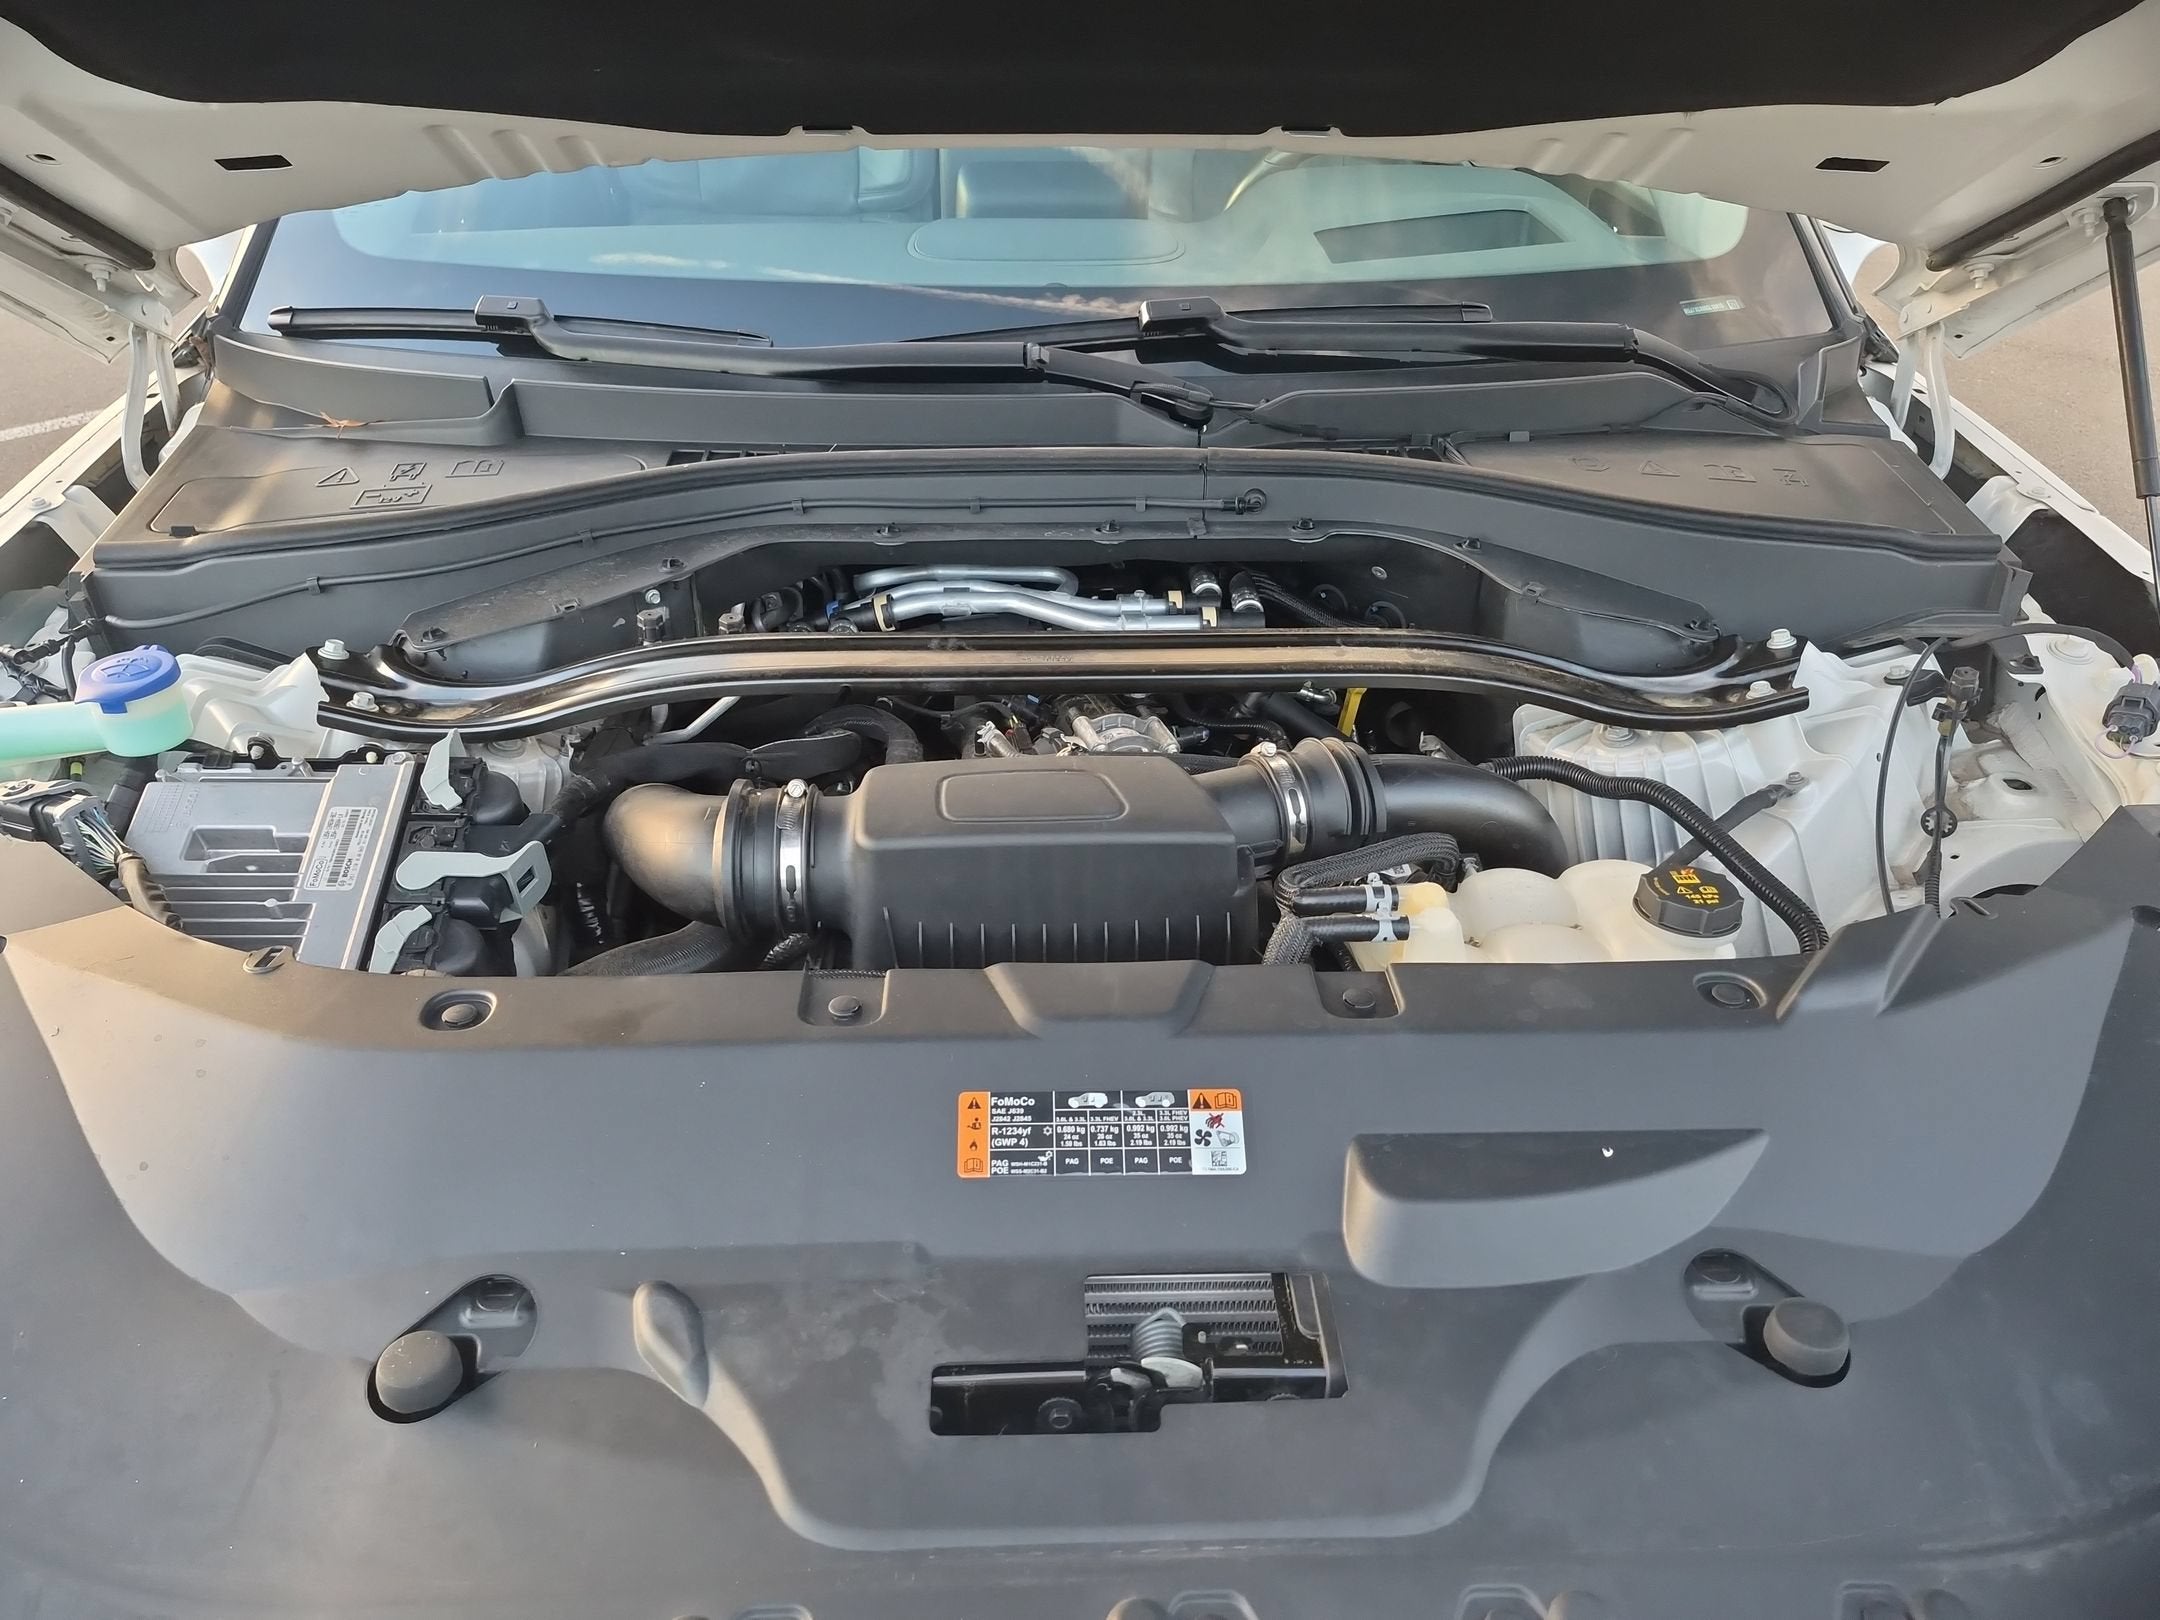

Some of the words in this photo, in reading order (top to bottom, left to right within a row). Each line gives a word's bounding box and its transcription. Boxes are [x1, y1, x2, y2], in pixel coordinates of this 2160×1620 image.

[310, 860, 324, 886] FoMoCo
[342, 859, 352, 878] BOSCH
[991, 1096, 1035, 1106] FoMoCo
[991, 1126, 1031, 1136] R-1234yf
[1077, 1126, 1085, 1134] kg
[1110, 1125, 1119, 1134] kg
[1146, 1125, 1155, 1134] kg
[1180, 1125, 1188, 1133] kg
[991, 1138, 1018, 1147] (GWP
[1019, 1138, 1028, 1147] 4)
